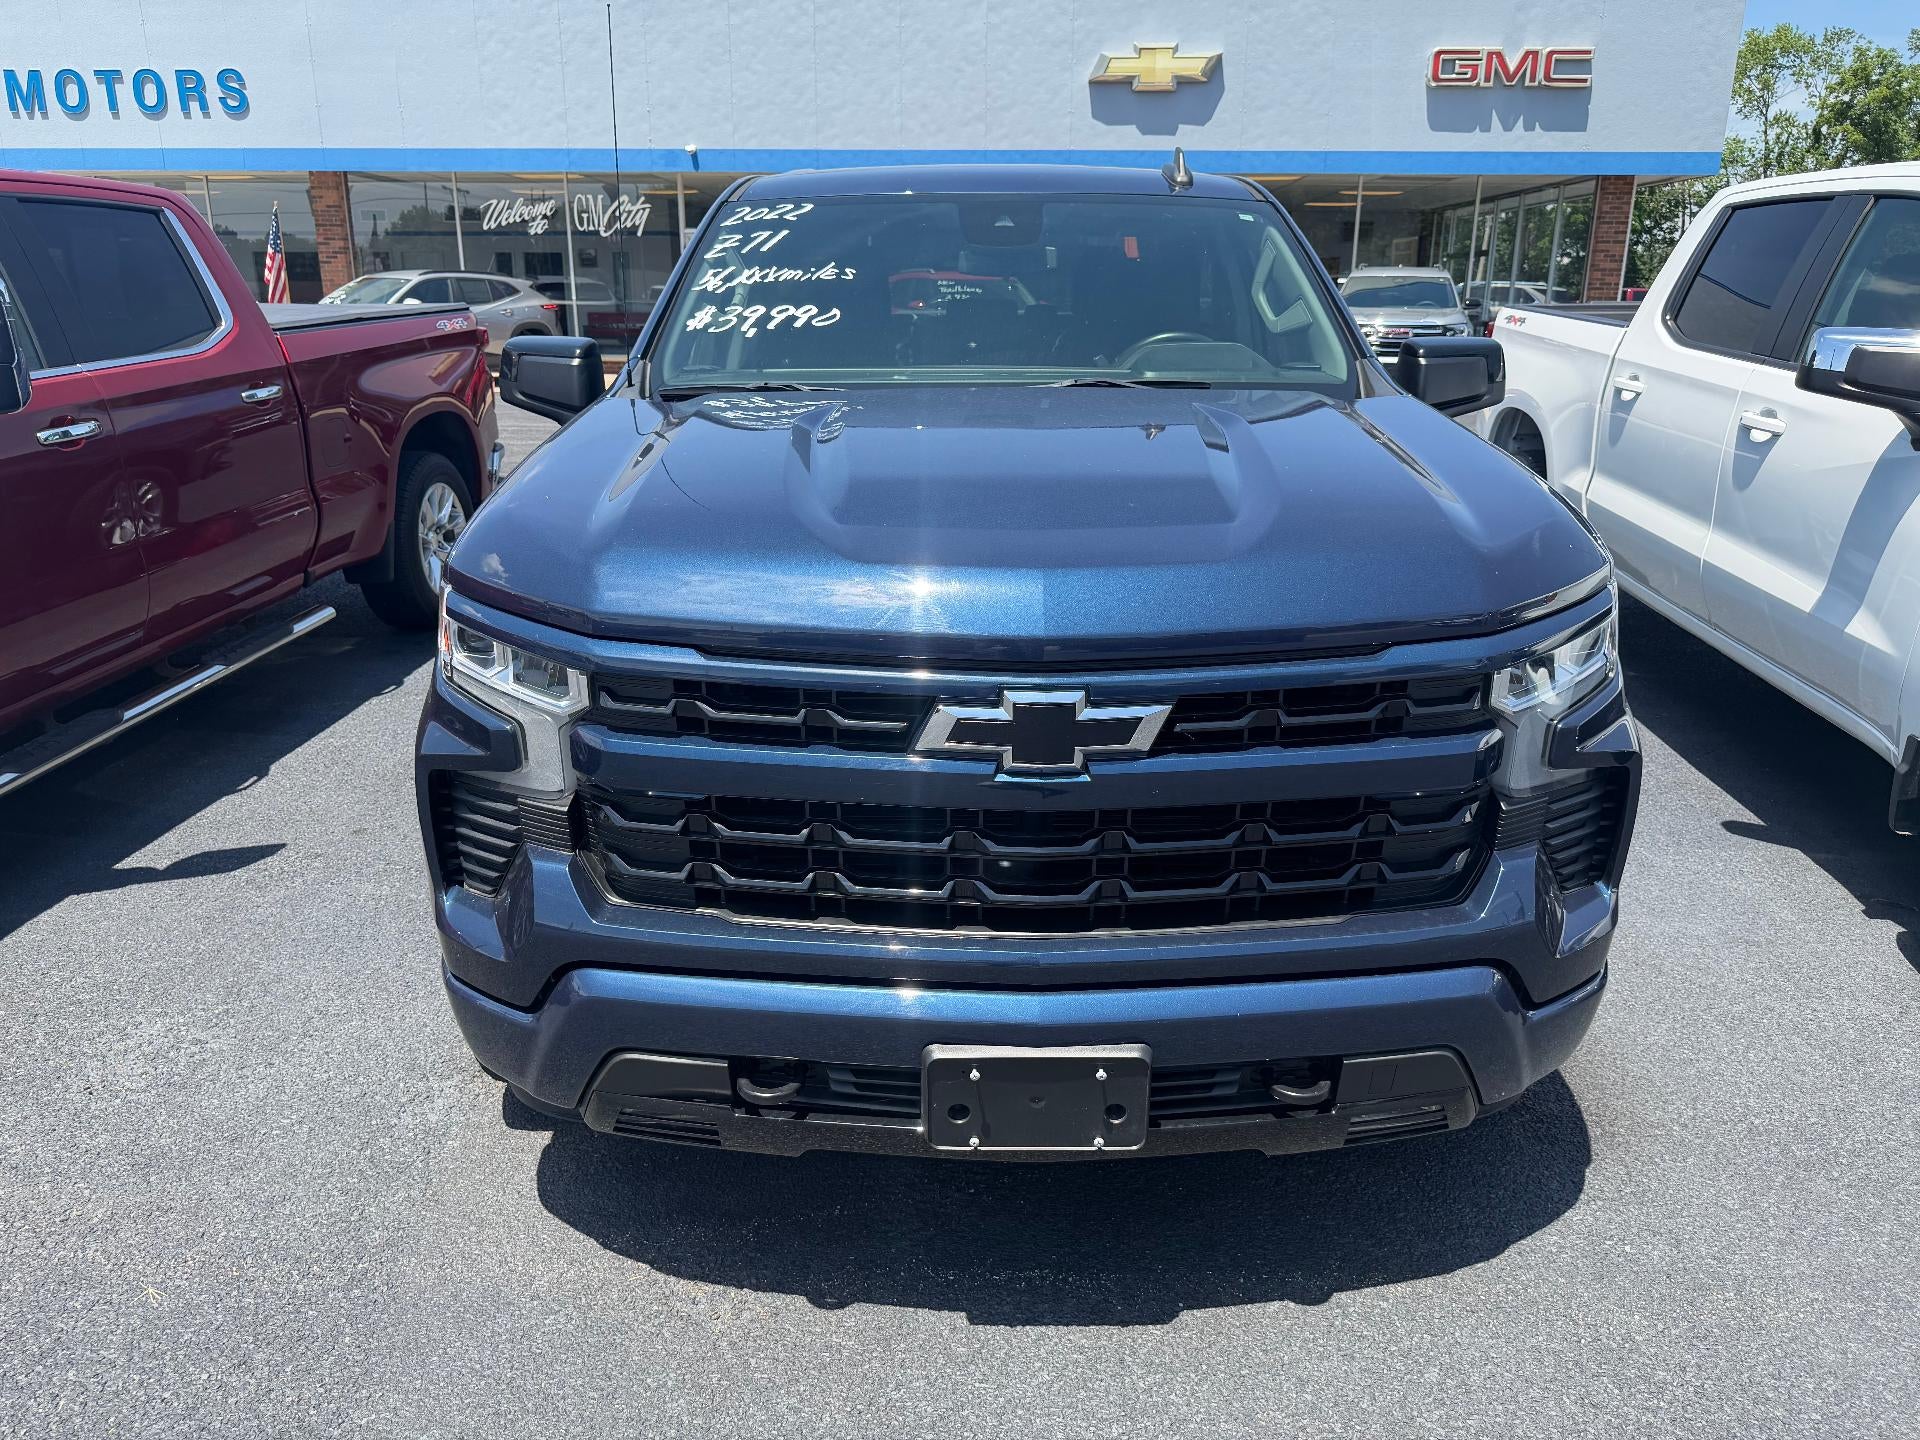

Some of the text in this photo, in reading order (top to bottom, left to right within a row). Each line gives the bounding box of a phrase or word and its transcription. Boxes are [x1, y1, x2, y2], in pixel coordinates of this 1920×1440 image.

[1427, 46, 1595, 88] GMC
[3, 68, 250, 114] MOTORS
[480, 197, 557, 231] Welcome
[527, 216, 550, 236] to
[720, 203, 815, 227] 2022
[685, 303, 842, 338] $39,990
